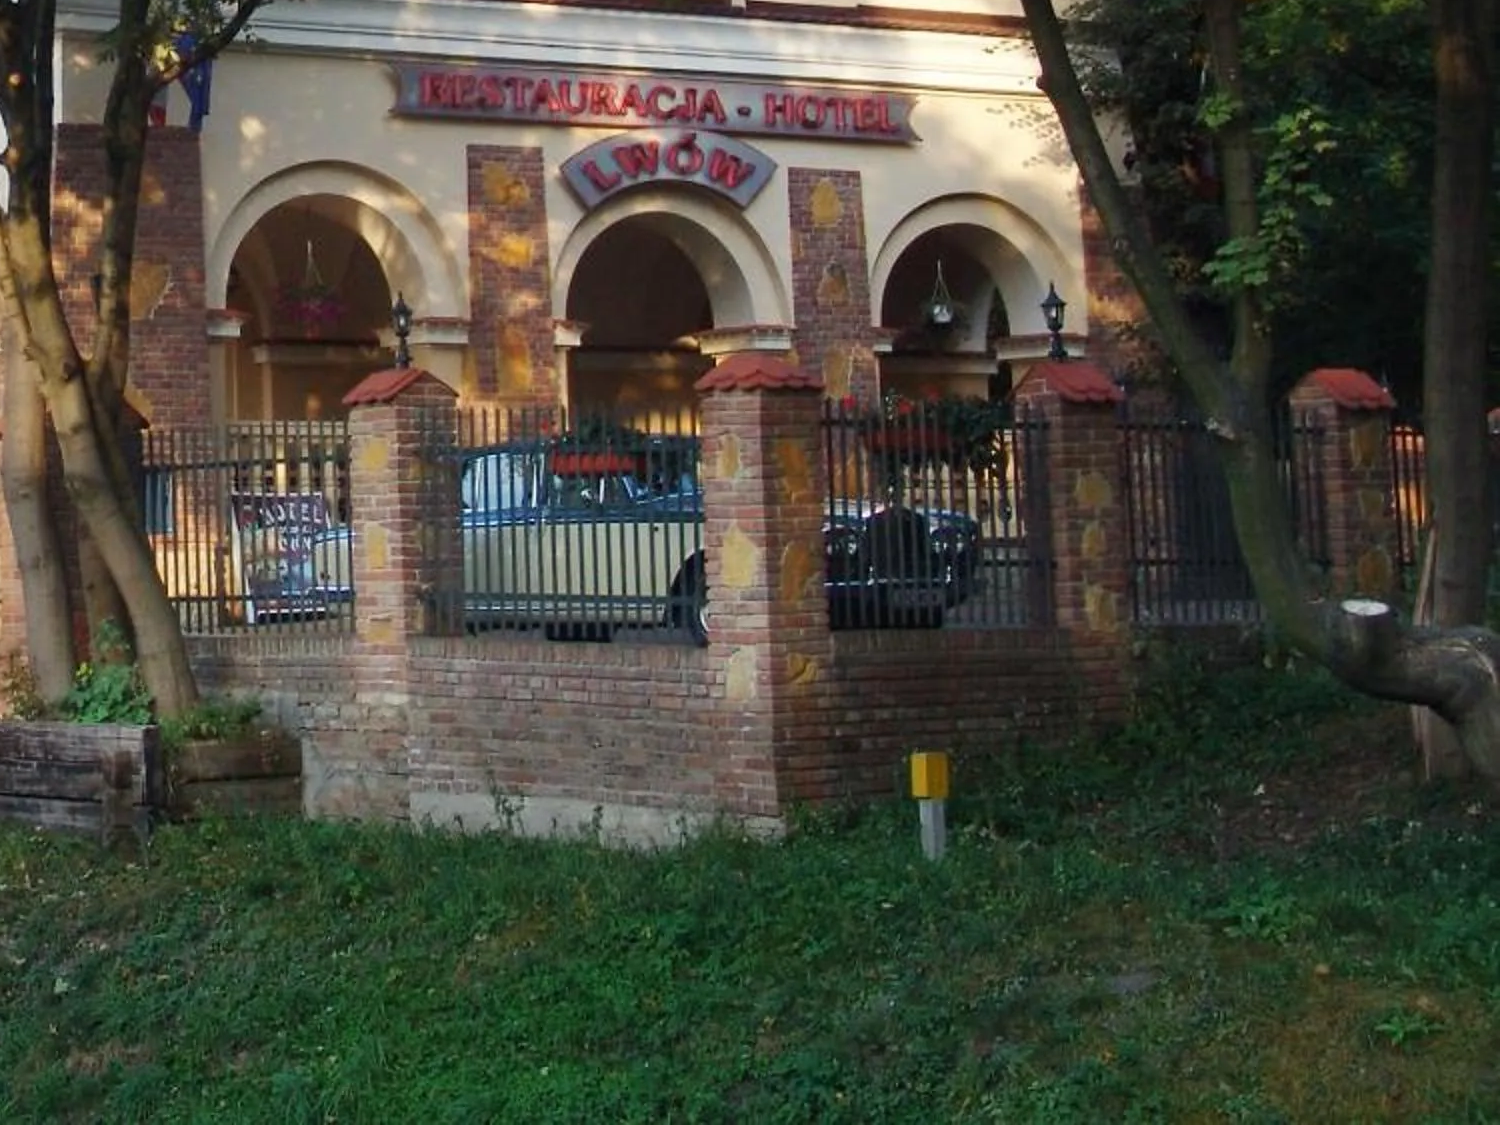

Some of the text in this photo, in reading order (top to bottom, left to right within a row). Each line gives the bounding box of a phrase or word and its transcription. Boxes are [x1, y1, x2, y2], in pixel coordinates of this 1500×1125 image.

[420, 70, 727, 124] RESTAURACJA
[763, 92, 899, 133] HOTEL
[580, 132, 756, 191] LWÓW
